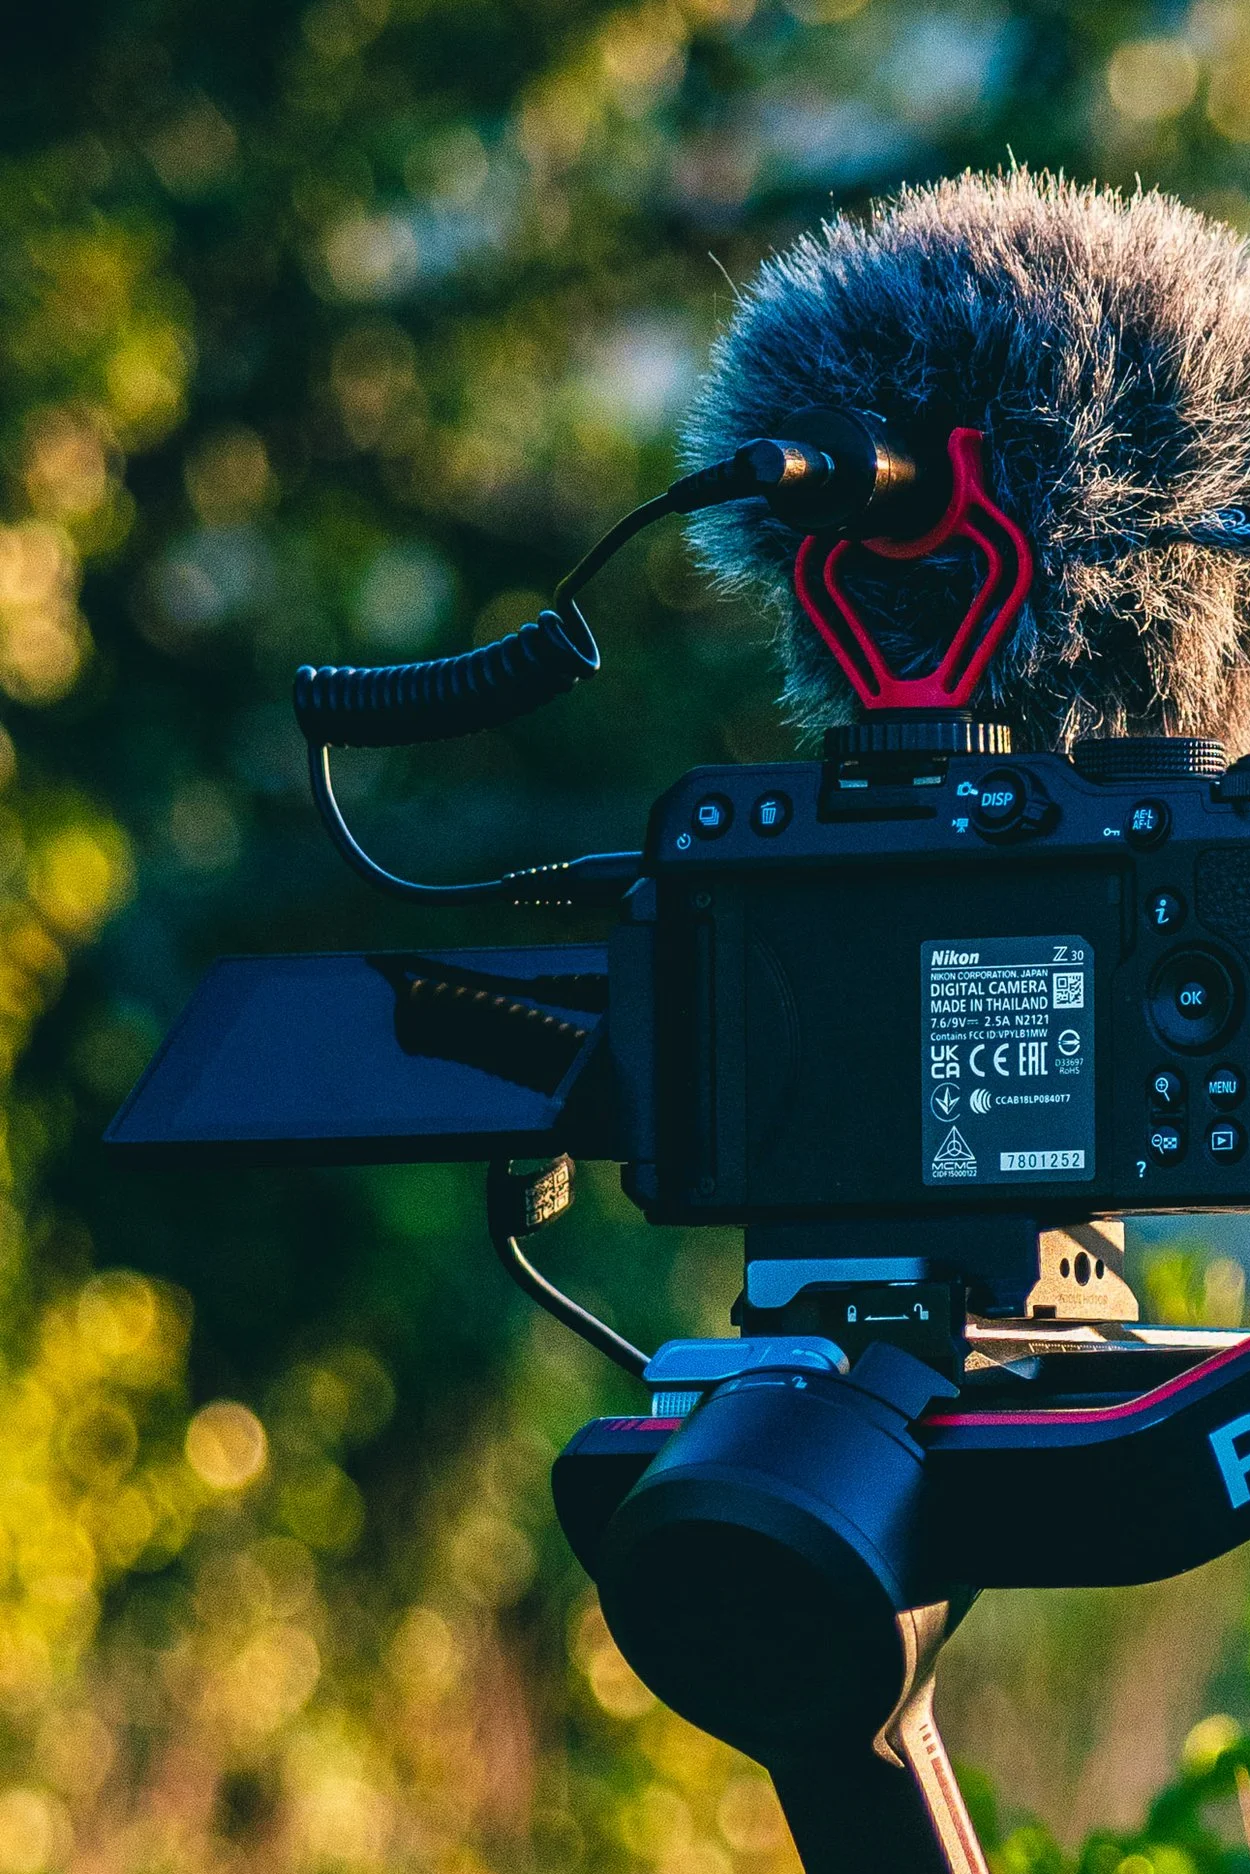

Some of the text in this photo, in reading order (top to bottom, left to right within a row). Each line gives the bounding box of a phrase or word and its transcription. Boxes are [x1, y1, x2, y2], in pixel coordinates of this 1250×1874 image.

[981, 792, 1013, 807] DISP
[931, 950, 980, 966] Nikon
[1052, 945, 1084, 962] Z 30
[931, 972, 956, 981] NIKON
[1020, 968, 1048, 978] JAPAN
[931, 979, 1048, 997] DIGITAL CAMERA
[931, 996, 1048, 1013] MADE IN THAILAND
[1180, 991, 1203, 1006] OK
[984, 1015, 1011, 1027] 2.5A
[1015, 1014, 1049, 1026] N2121
[930, 1032, 967, 1041] Contains
[969, 1030, 984, 1040] FCC
[931, 1045, 960, 1062] UK
[969, 1043, 1010, 1078] CE
[1055, 1058, 1083, 1067] D33697
[931, 1062, 960, 1079] CA
[1208, 1080, 1237, 1094] MENU
[932, 1161, 977, 1170] MCMC
[1007, 1152, 1080, 1169] 7801252
